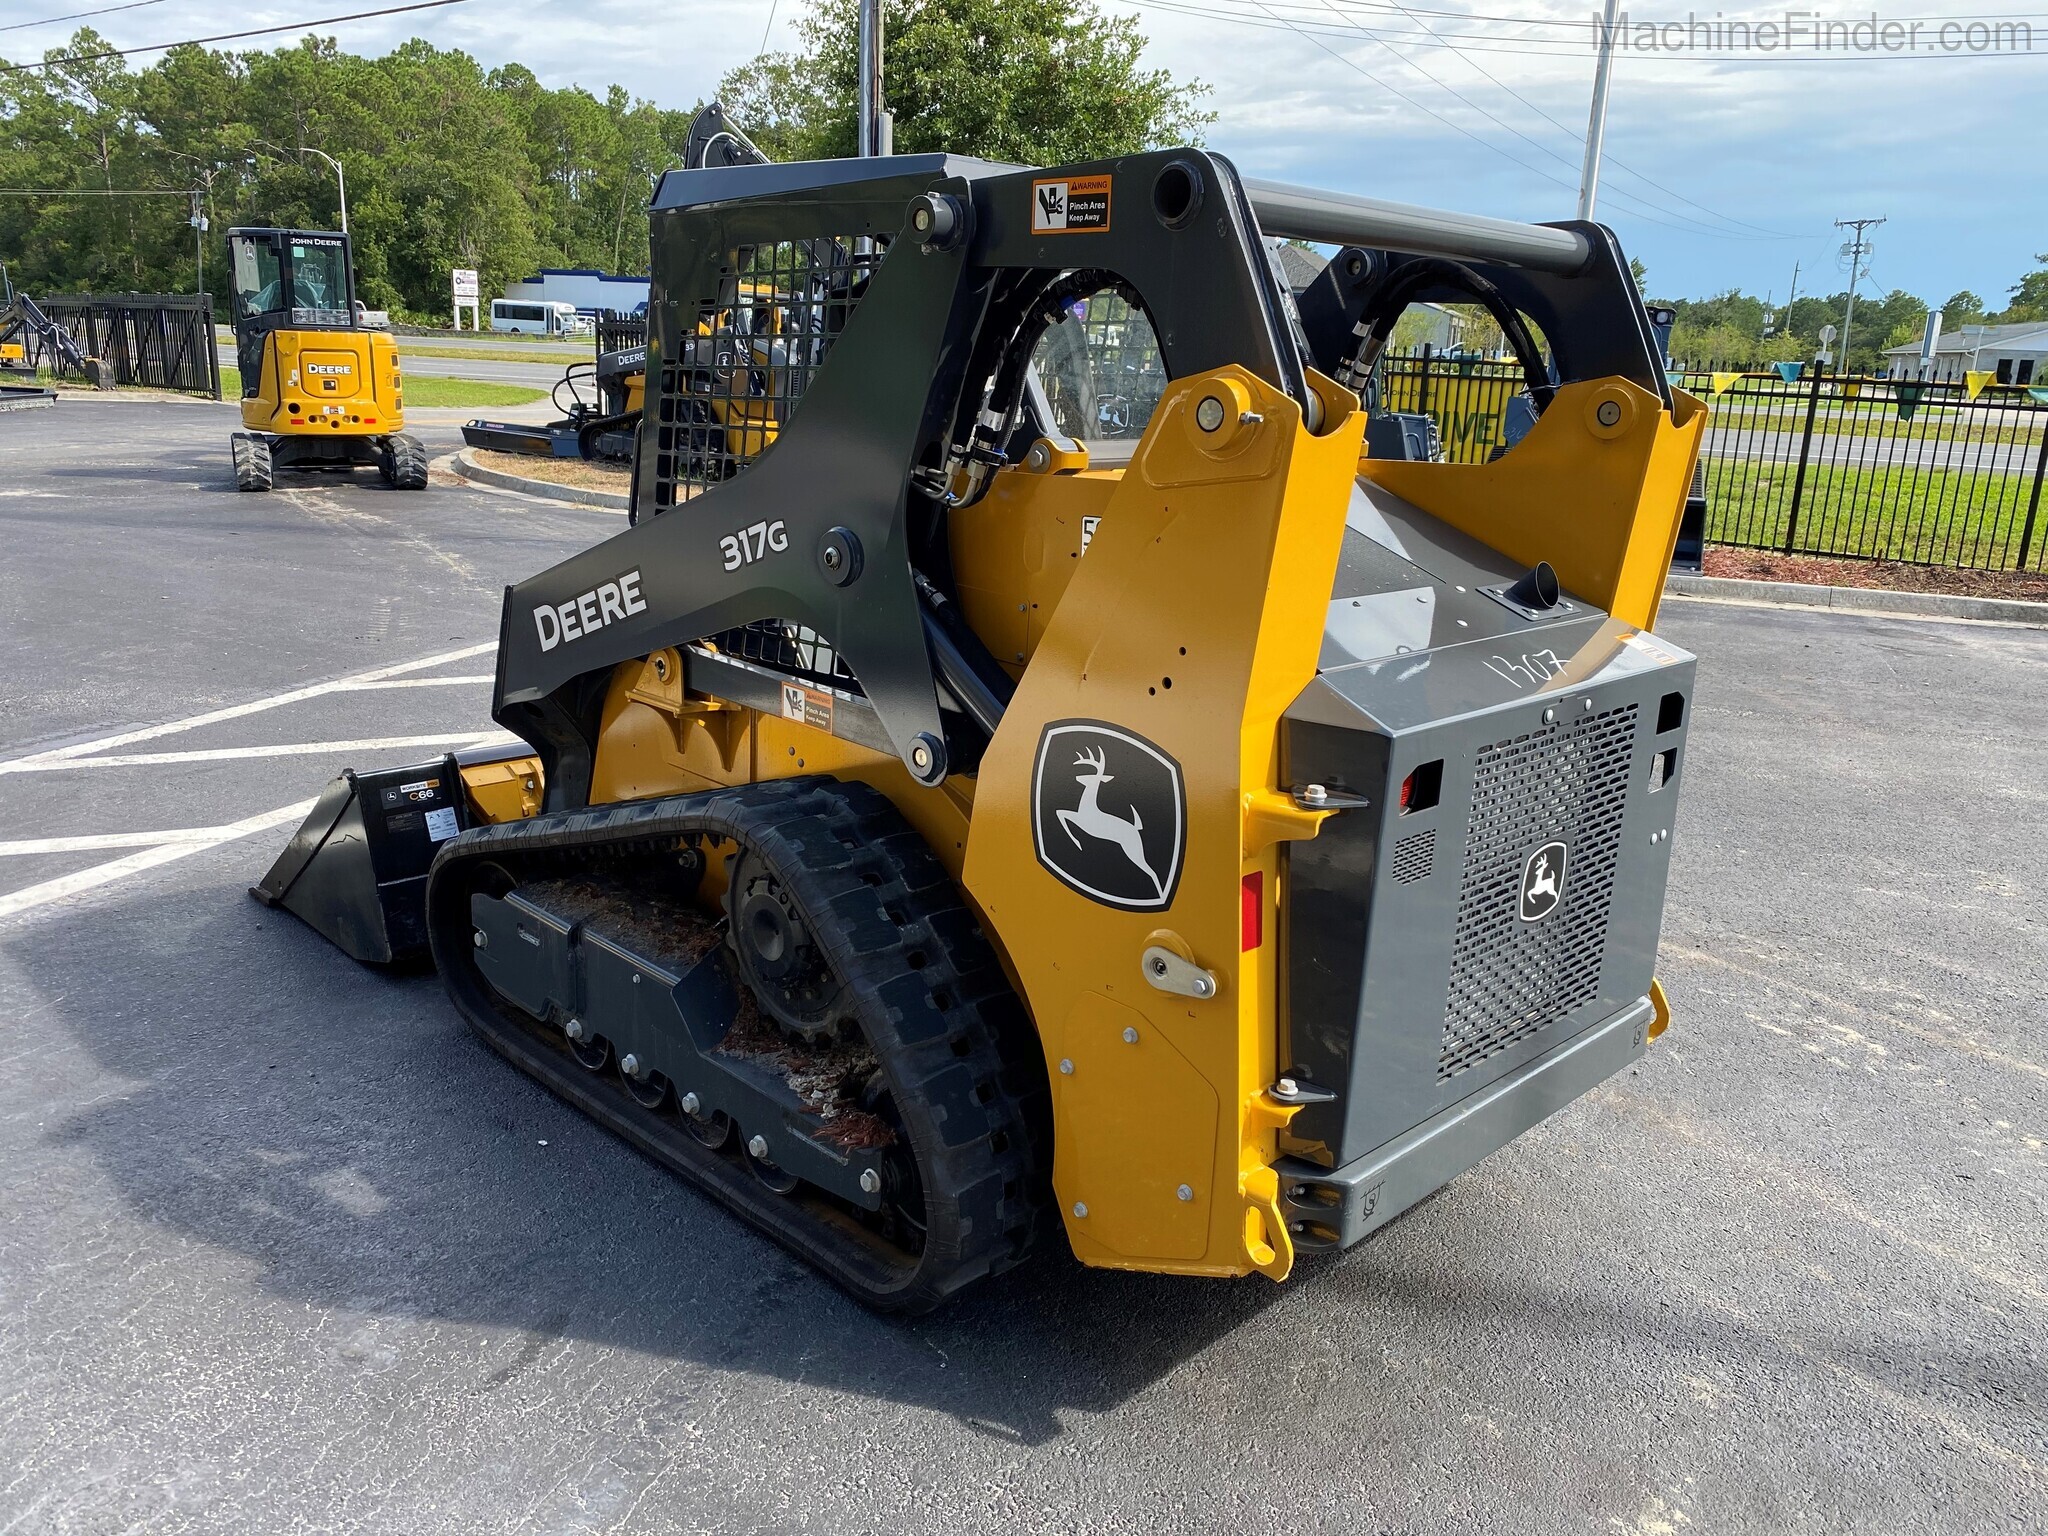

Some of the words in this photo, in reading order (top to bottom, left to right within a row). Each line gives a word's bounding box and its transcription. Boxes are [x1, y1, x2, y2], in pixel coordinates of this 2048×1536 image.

[1077, 181, 1107, 190] WARNING
[1069, 202, 1089, 211] Pinch
[1089, 201, 1106, 210] Area
[1069, 214, 1083, 222] Keep
[1084, 213, 1100, 222] Away
[290, 237, 313, 246] JOHN
[314, 238, 342, 247] DEERE
[618, 352, 646, 366] DEERE
[308, 363, 352, 375] DEERE
[720, 520, 789, 571] 317G
[533, 571, 647, 652] DEERE
[402, 783, 426, 791] WORKSITE
[409, 789, 434, 801] C66
